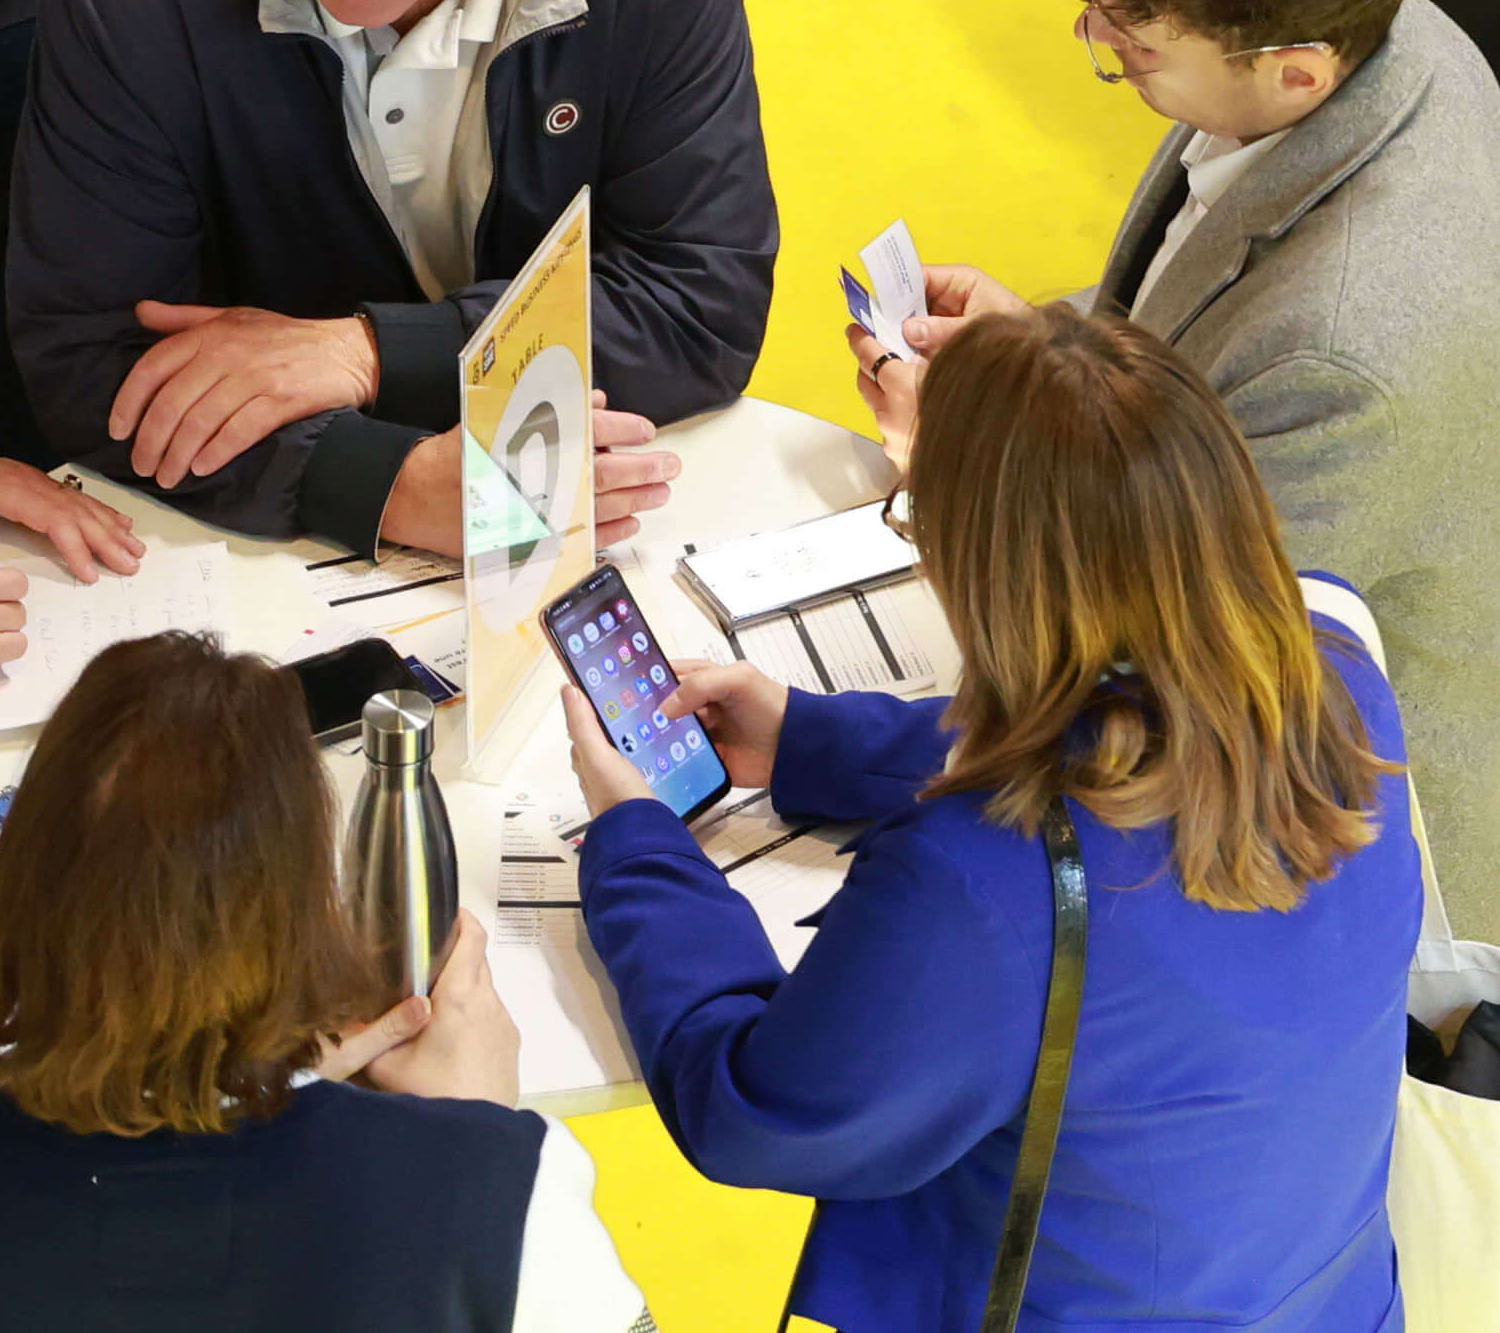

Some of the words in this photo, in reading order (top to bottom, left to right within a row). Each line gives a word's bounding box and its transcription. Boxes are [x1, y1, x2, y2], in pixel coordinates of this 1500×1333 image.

[500, 308, 521, 343] SPEED
[511, 333, 544, 385] TABLE
[504, 399, 560, 587] D
